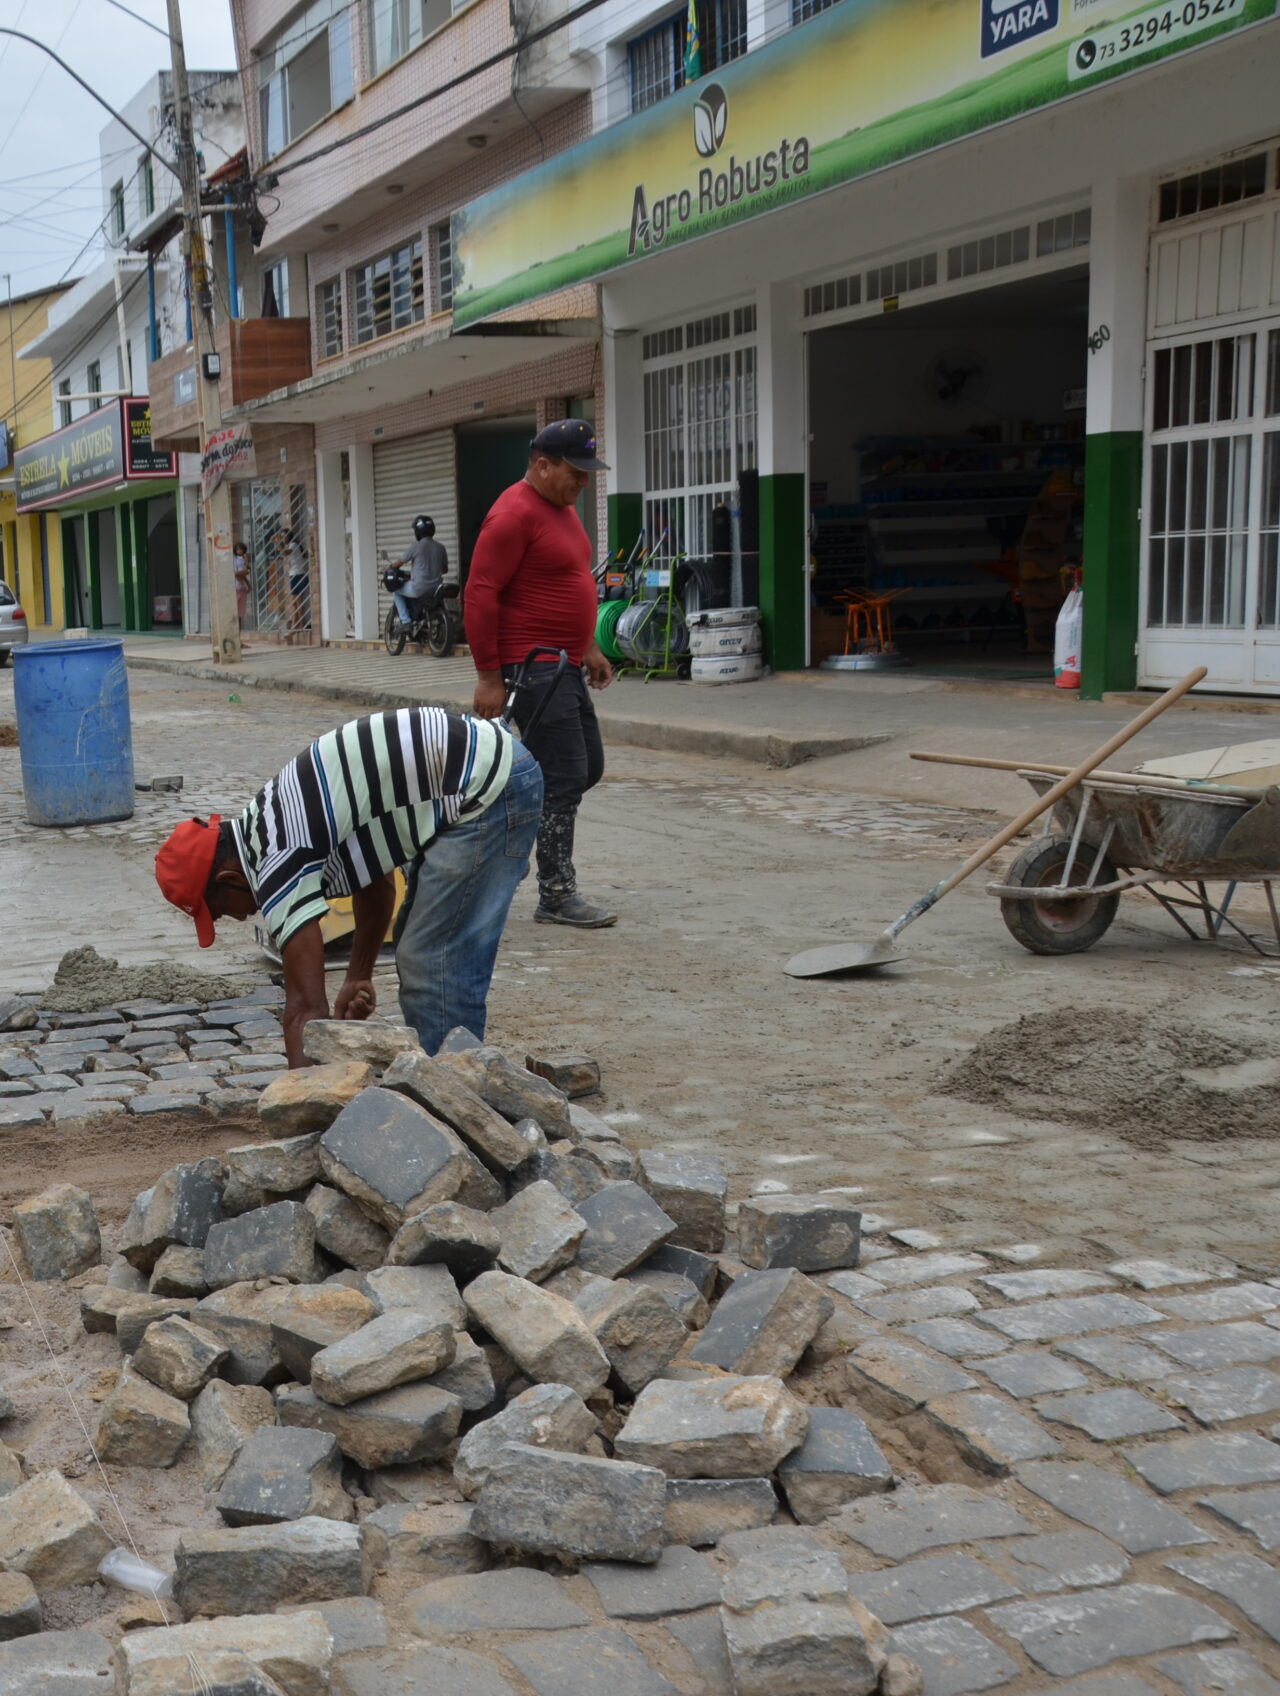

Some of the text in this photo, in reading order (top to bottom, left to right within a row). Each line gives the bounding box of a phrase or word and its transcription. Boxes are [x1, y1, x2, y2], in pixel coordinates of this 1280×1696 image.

[990, 1, 1049, 44] YARA
[1100, 43, 1115, 61] 73
[627, 137, 810, 256] Agro Robusta
[131, 420, 152, 428] ESTR
[20, 453, 57, 486] ESTRELA
[71, 425, 113, 467] MÓVEIS
